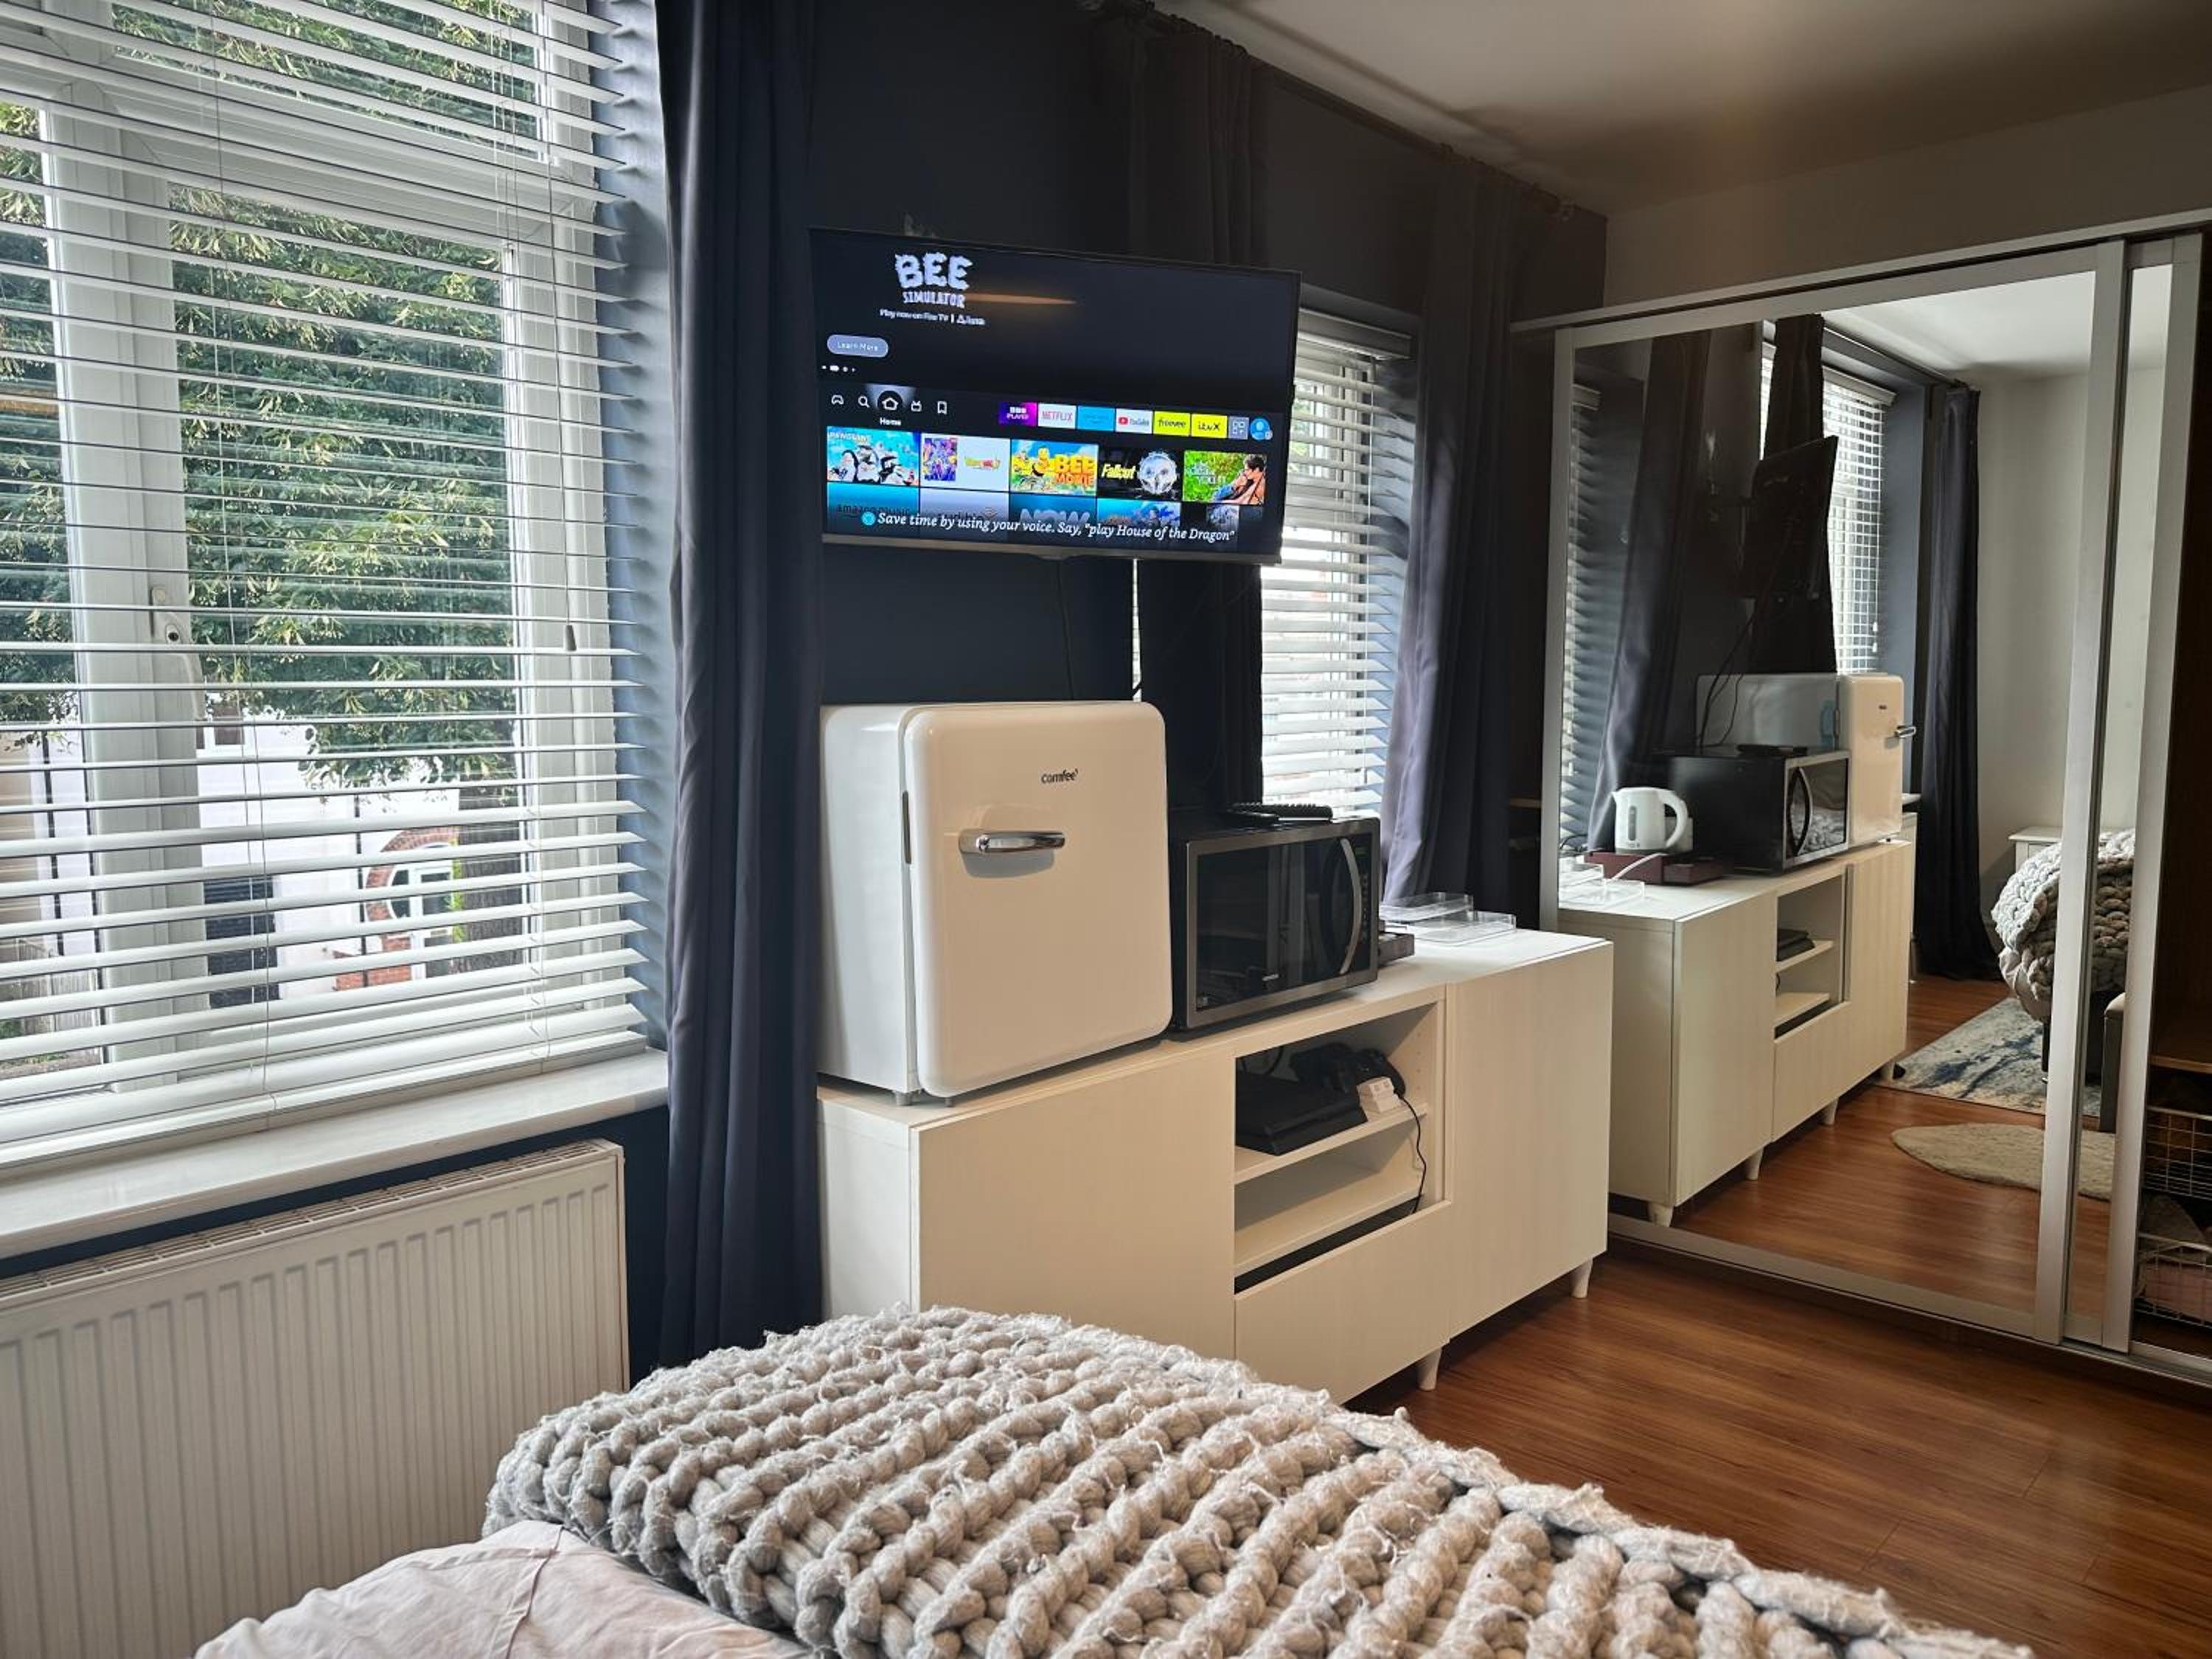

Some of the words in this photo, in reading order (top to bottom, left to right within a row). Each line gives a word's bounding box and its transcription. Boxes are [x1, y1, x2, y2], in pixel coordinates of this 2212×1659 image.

[894, 251, 973, 291] BEE
[902, 290, 966, 309] SIMULATOR
[837, 341, 859, 349] Learn
[860, 343, 878, 351] More
[880, 417, 902, 426] Home
[1042, 410, 1074, 422] NETFLIX
[1054, 453, 1096, 473] BEE
[1102, 464, 1136, 479] Fallout
[1055, 472, 1095, 488] MOVIE
[877, 512, 907, 524] Save
[909, 515, 937, 526] time
[940, 515, 955, 530] by
[958, 517, 990, 532] using
[990, 521, 1021, 533] your
[1023, 521, 1055, 533] voice.
[1057, 522, 1082, 536] Say,
[1085, 524, 1114, 538] "play
[1116, 524, 1151, 538] House
[1154, 526, 1169, 540] of
[1169, 527, 1188, 539] the
[1189, 528, 1236, 543] Dragon"
